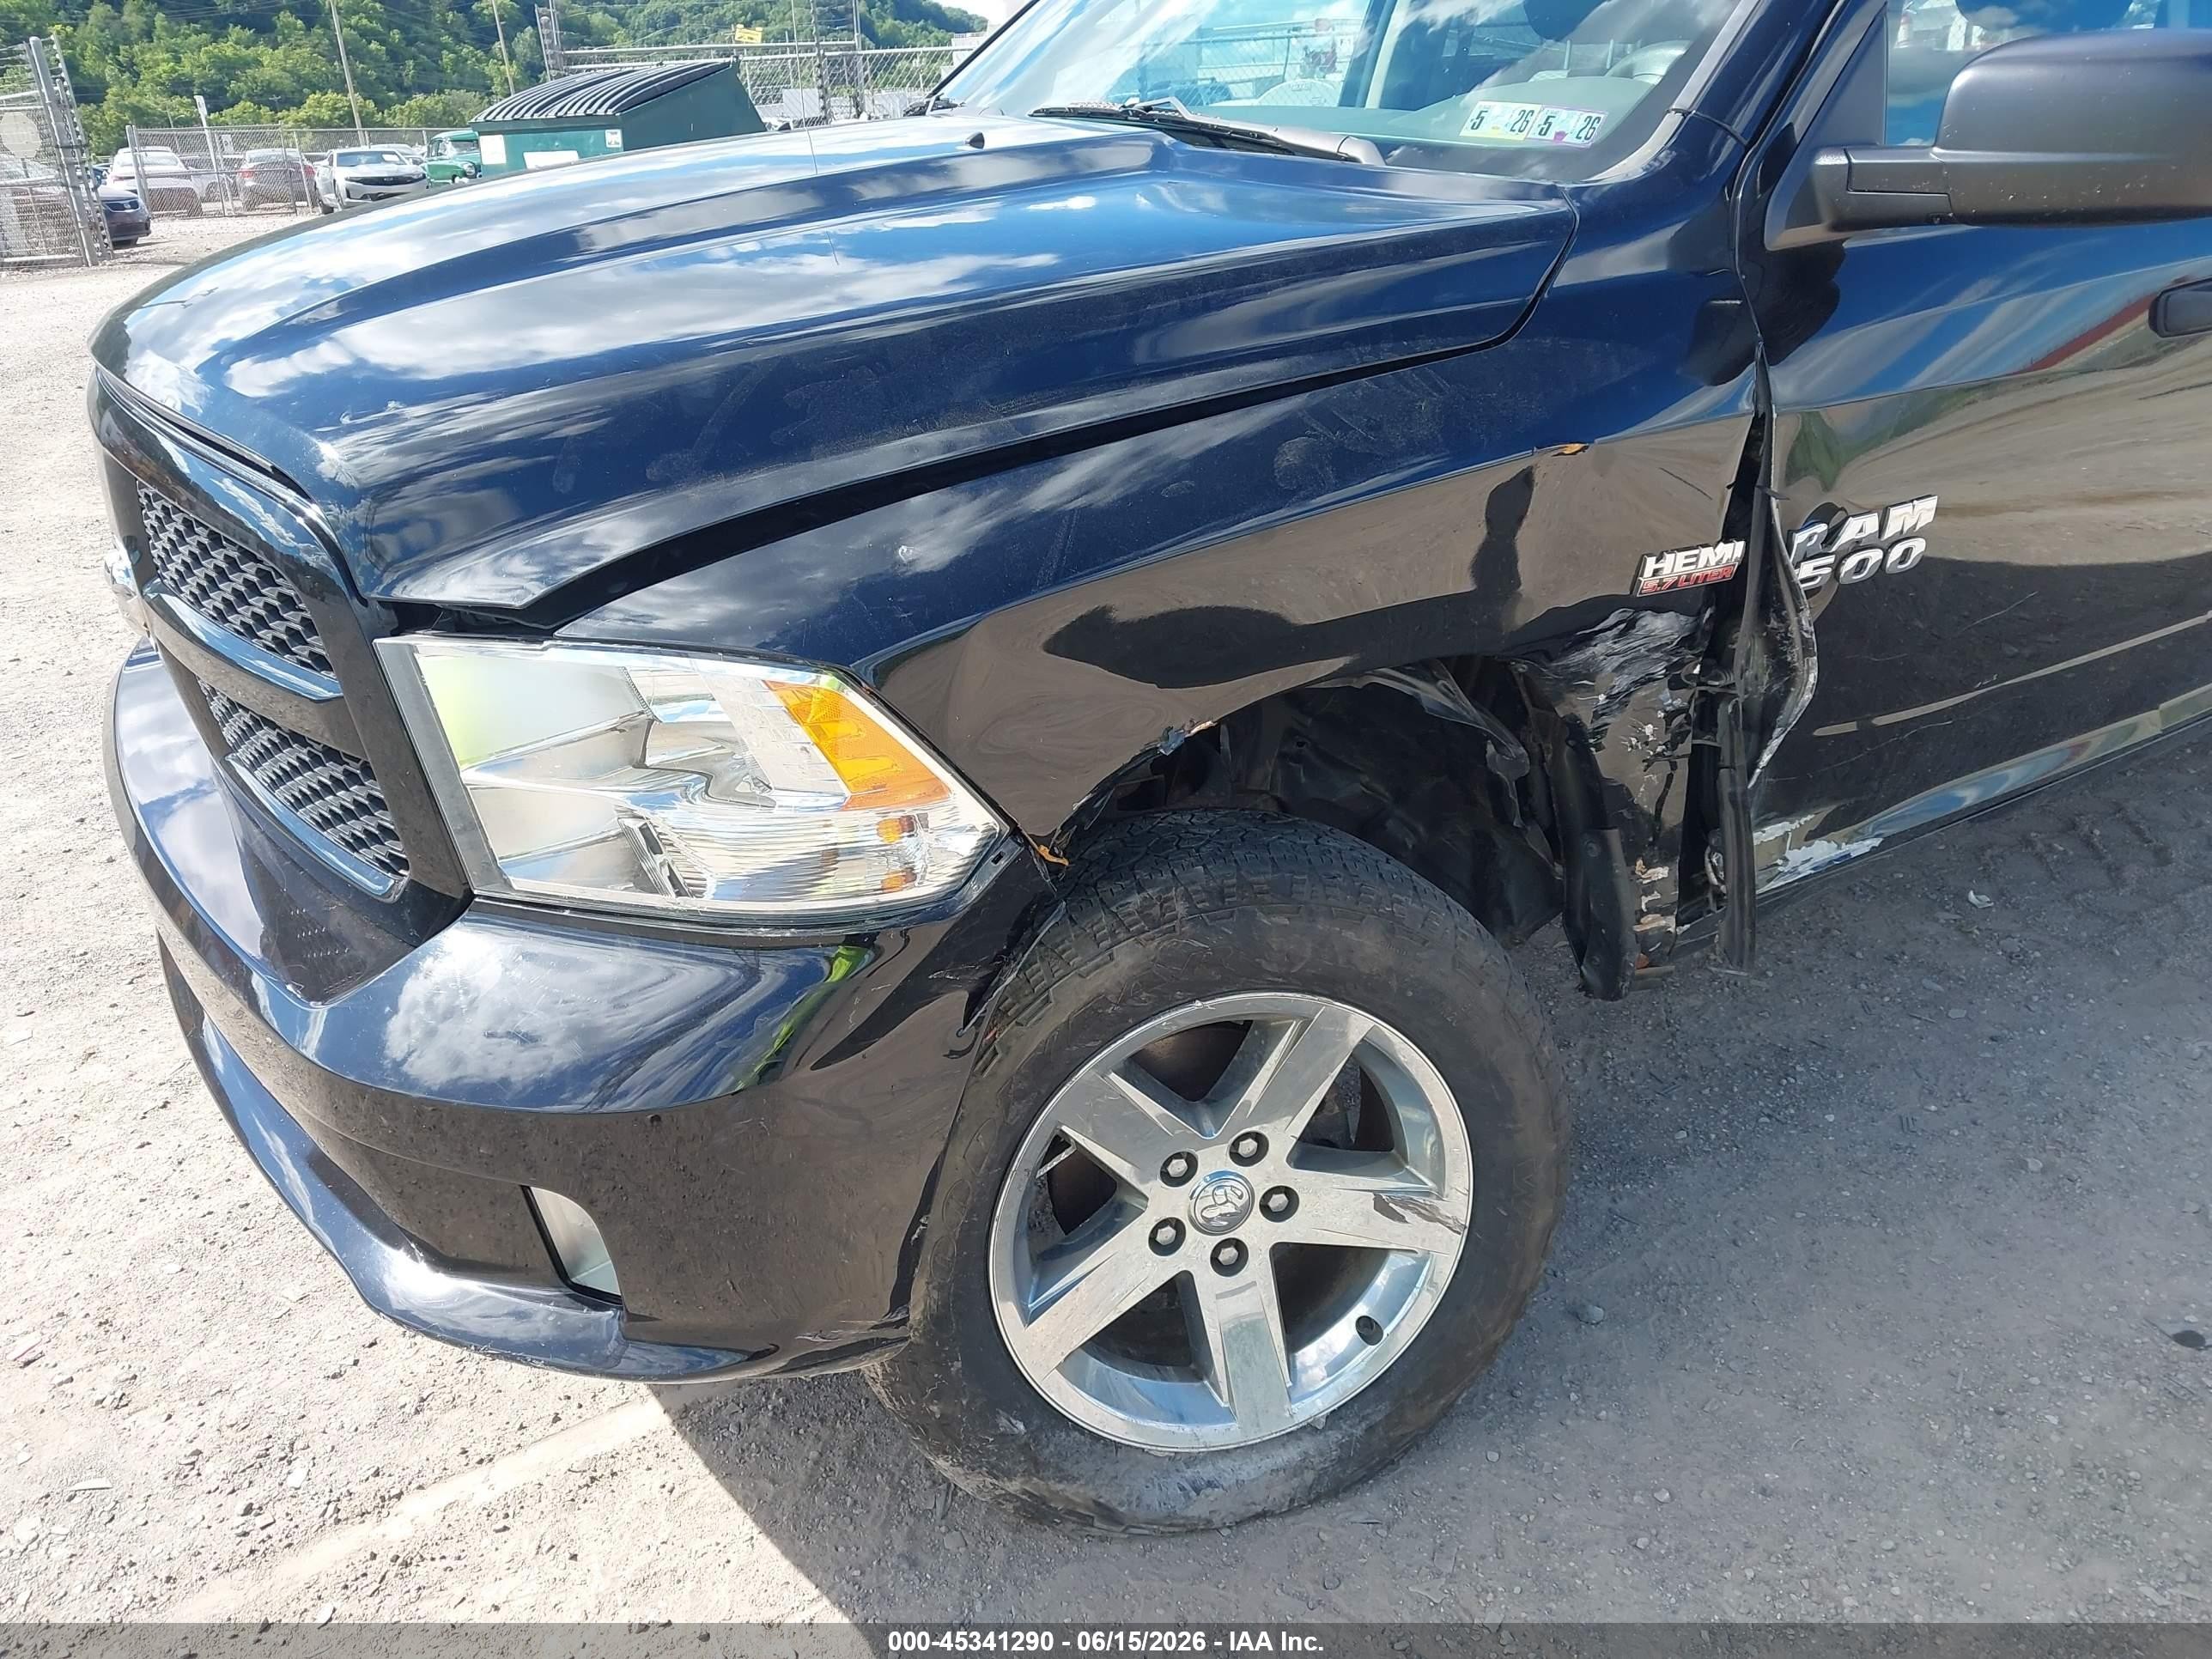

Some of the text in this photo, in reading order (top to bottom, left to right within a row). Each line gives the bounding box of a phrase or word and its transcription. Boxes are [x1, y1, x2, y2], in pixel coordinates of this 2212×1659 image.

[1470, 109, 1534, 133] 5 26
[1537, 115, 1601, 141] 5 26
[1790, 495, 1938, 565] RAM
[1641, 539, 1745, 579] HEMI
[1794, 536, 1927, 592] 500
[1640, 565, 1734, 595] 5.7 LITER
